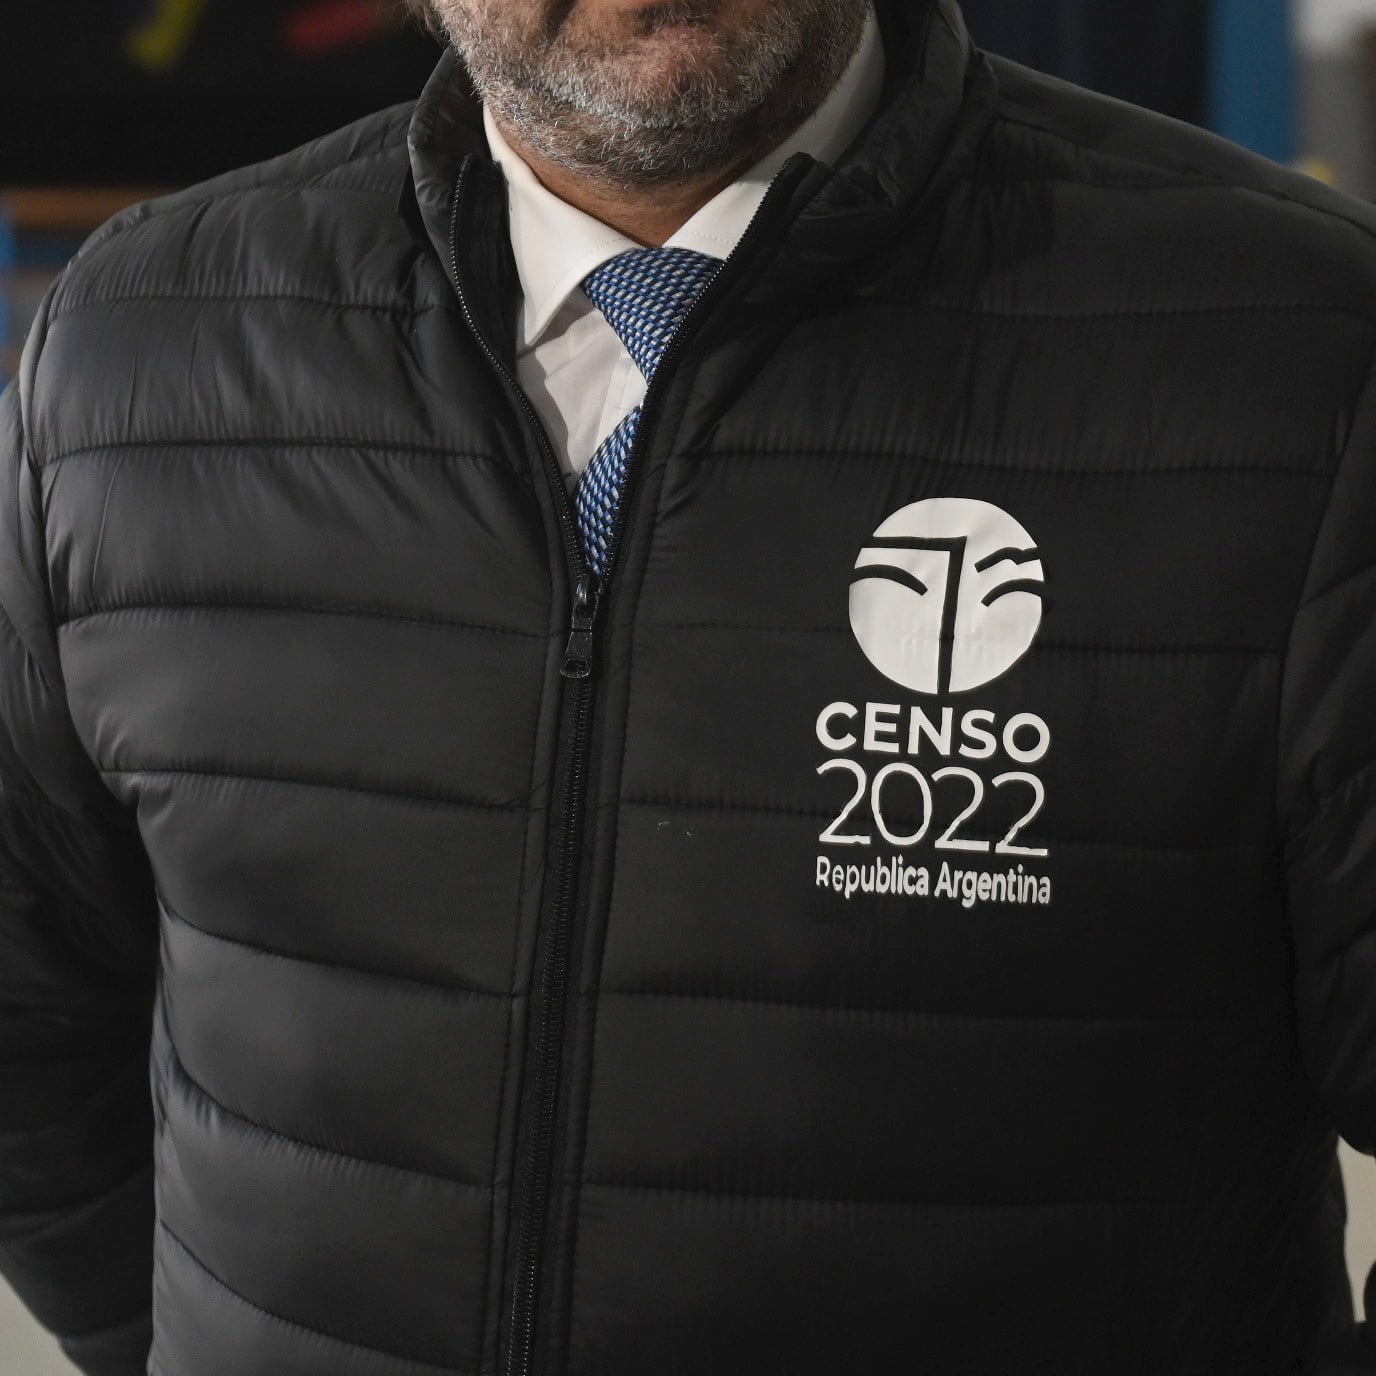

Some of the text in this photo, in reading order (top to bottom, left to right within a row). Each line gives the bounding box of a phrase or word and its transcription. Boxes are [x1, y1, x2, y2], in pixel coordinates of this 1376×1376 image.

[815, 701, 1051, 764] CENSO
[815, 757, 1049, 857] 2022
[815, 854, 1052, 909] Republica Argentina
